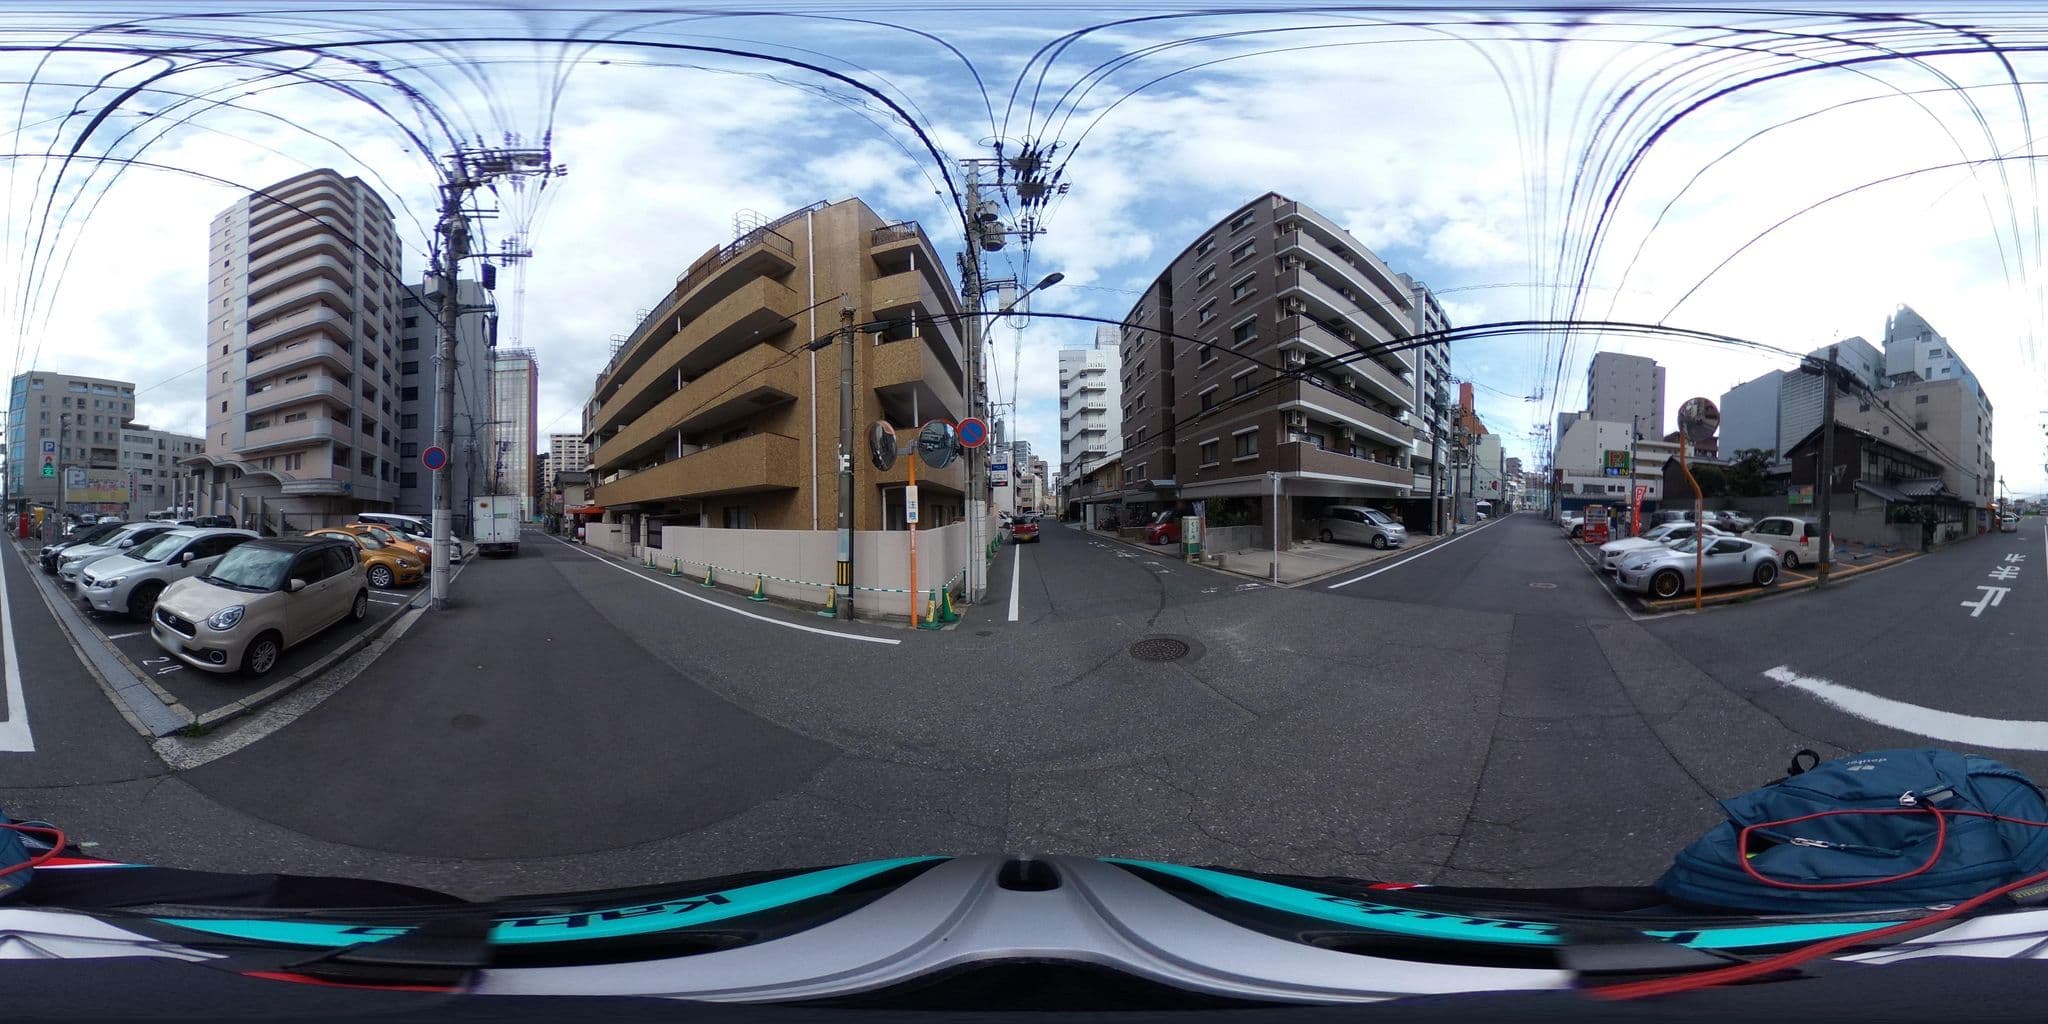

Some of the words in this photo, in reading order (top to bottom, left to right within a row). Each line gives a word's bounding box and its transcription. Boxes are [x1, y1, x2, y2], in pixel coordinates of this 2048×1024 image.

[45, 442, 53, 451] P
[69, 470, 85, 487] P
[1960, 553, 2027, 617] 止まれ
